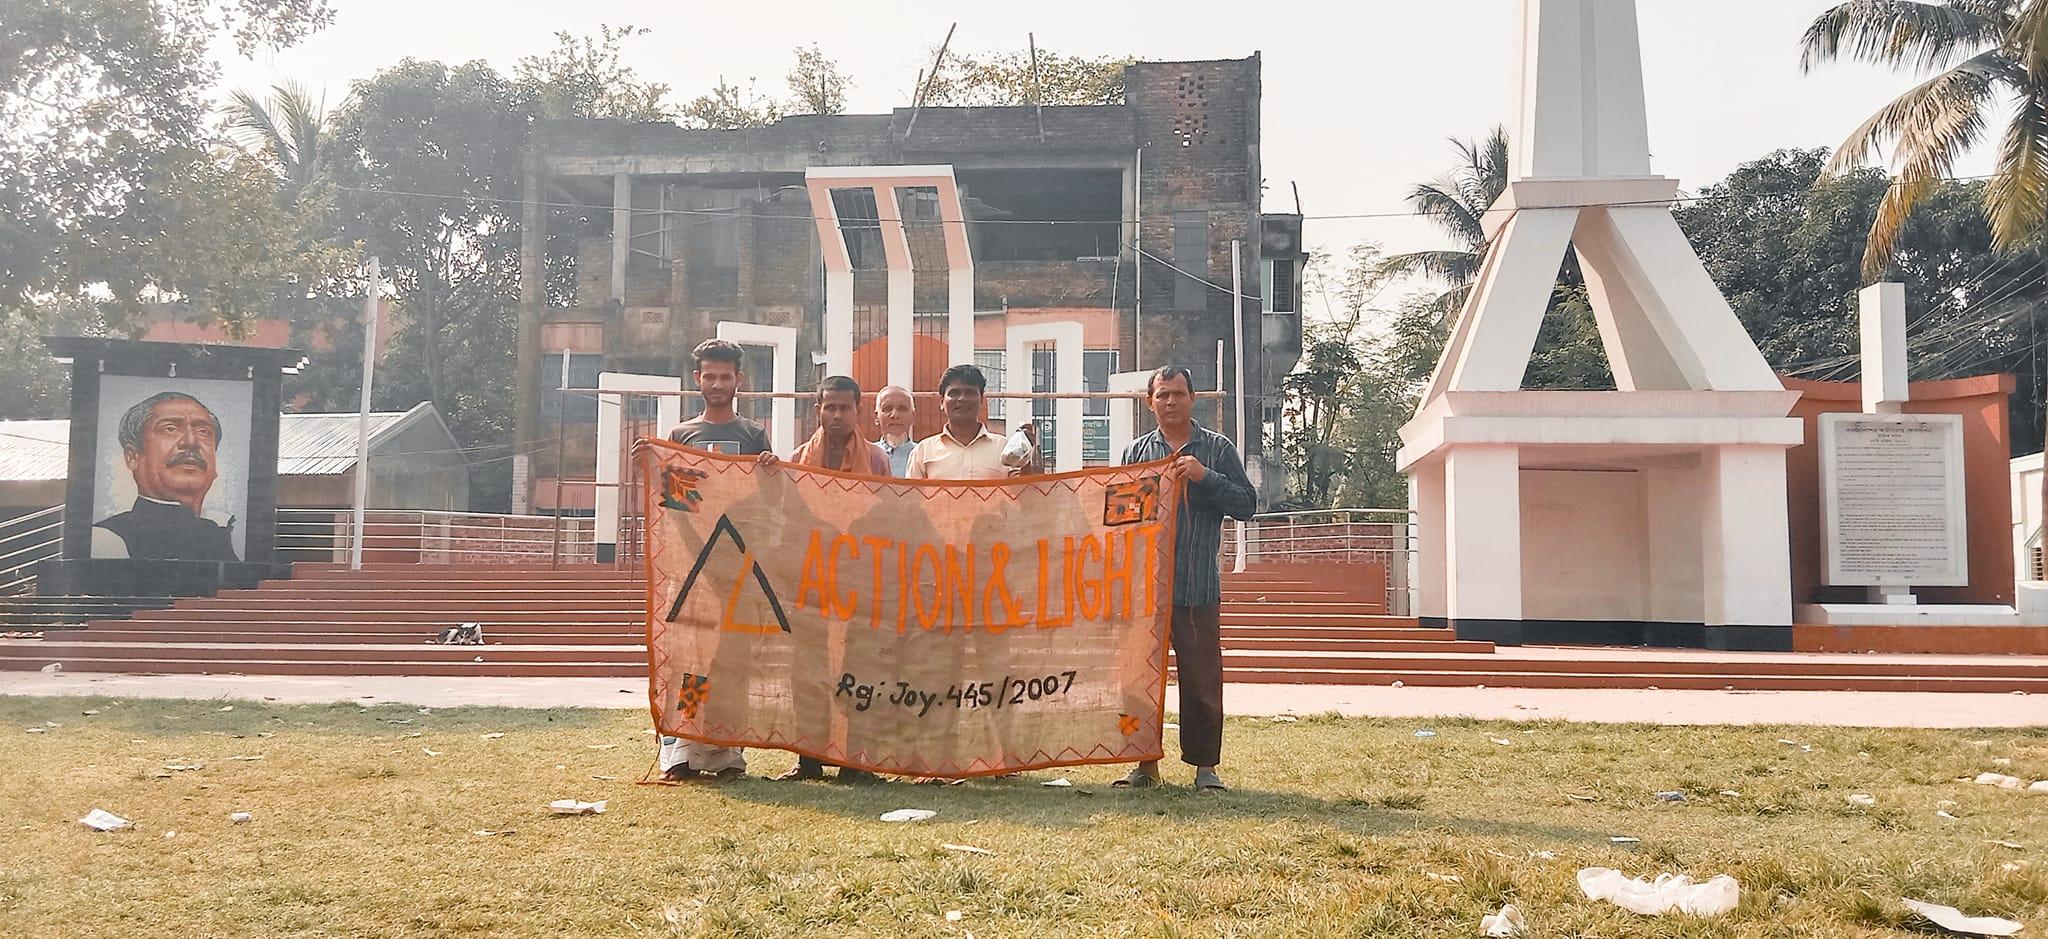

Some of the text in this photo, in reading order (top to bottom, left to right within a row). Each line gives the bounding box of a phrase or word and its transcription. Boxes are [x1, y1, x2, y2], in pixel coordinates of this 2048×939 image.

[796, 526, 1162, 635] ACTION & LIGHT
